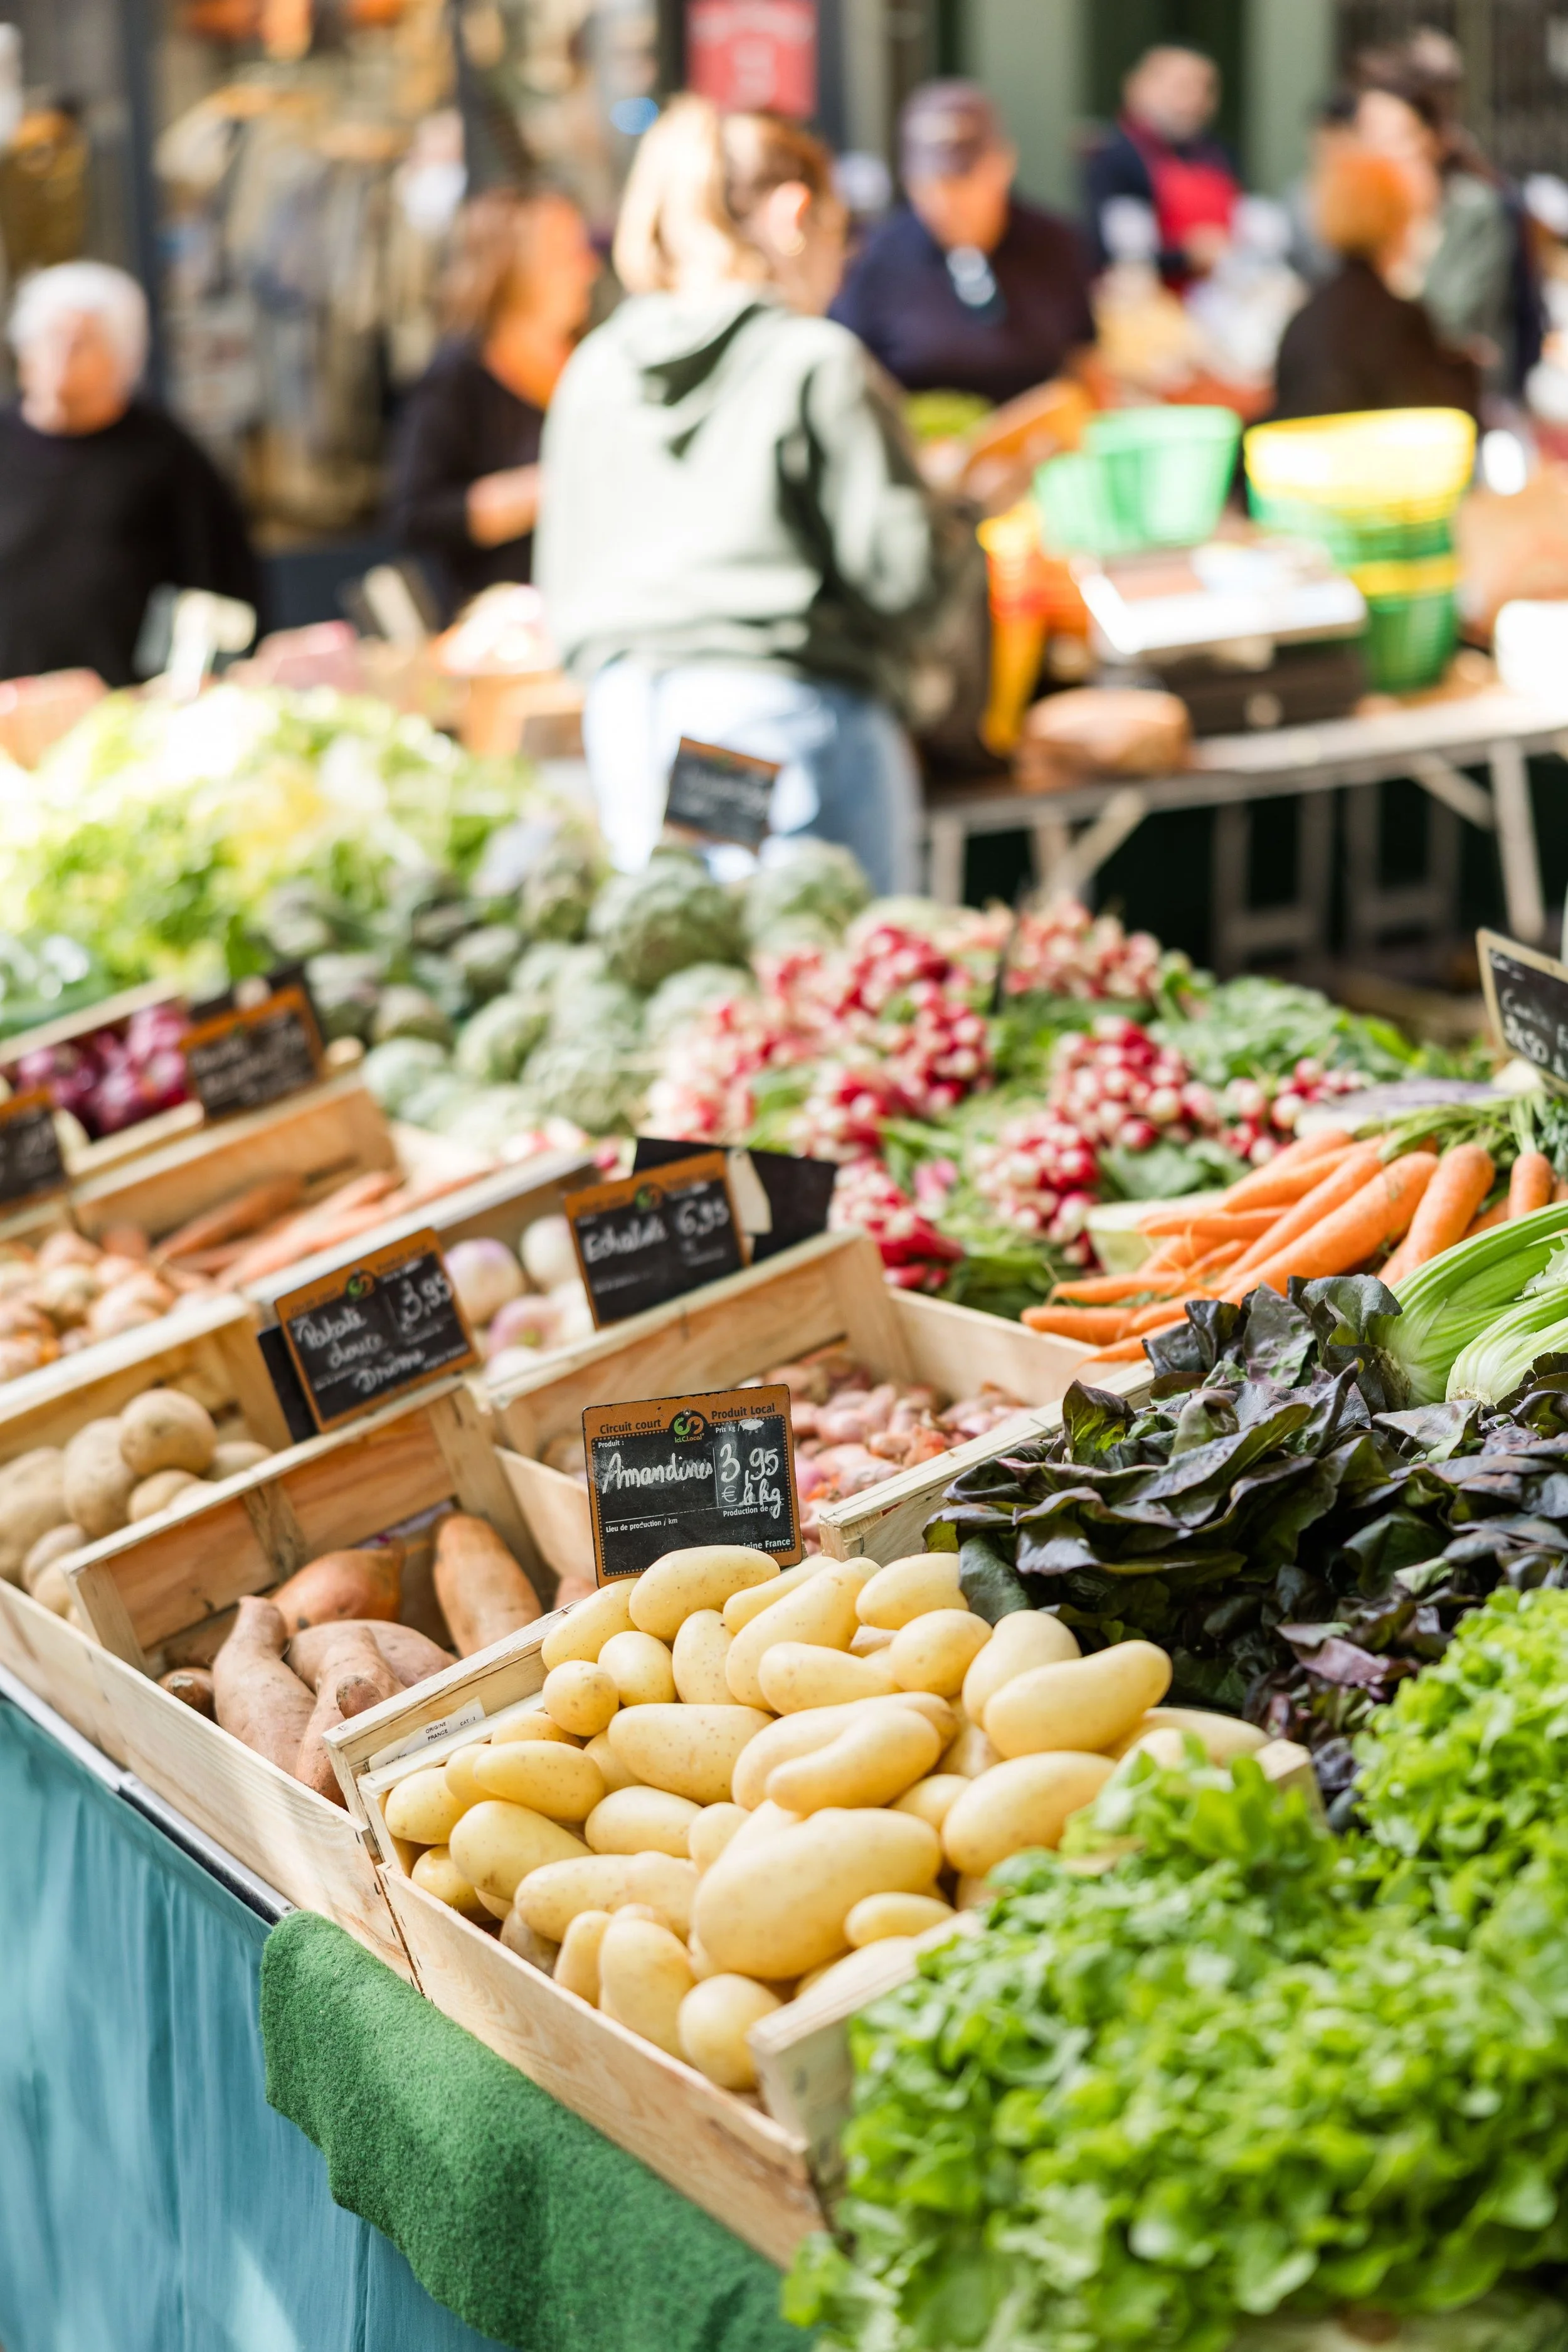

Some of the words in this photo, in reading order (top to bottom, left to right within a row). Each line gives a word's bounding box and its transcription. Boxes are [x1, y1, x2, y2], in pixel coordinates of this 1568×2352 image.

[711, 1407, 747, 1419] Produit
[750, 1402, 775, 1415] Local
[600, 1421, 632, 1434] Circuit
[635, 1419, 661, 1431] court
[598, 1439, 620, 1448] Produit
[723, 1507, 758, 1517] Production
[765, 1539, 791, 1548] France
[425, 1722, 447, 1734] ORIGINE
[428, 1729, 448, 1741] FRANCE
